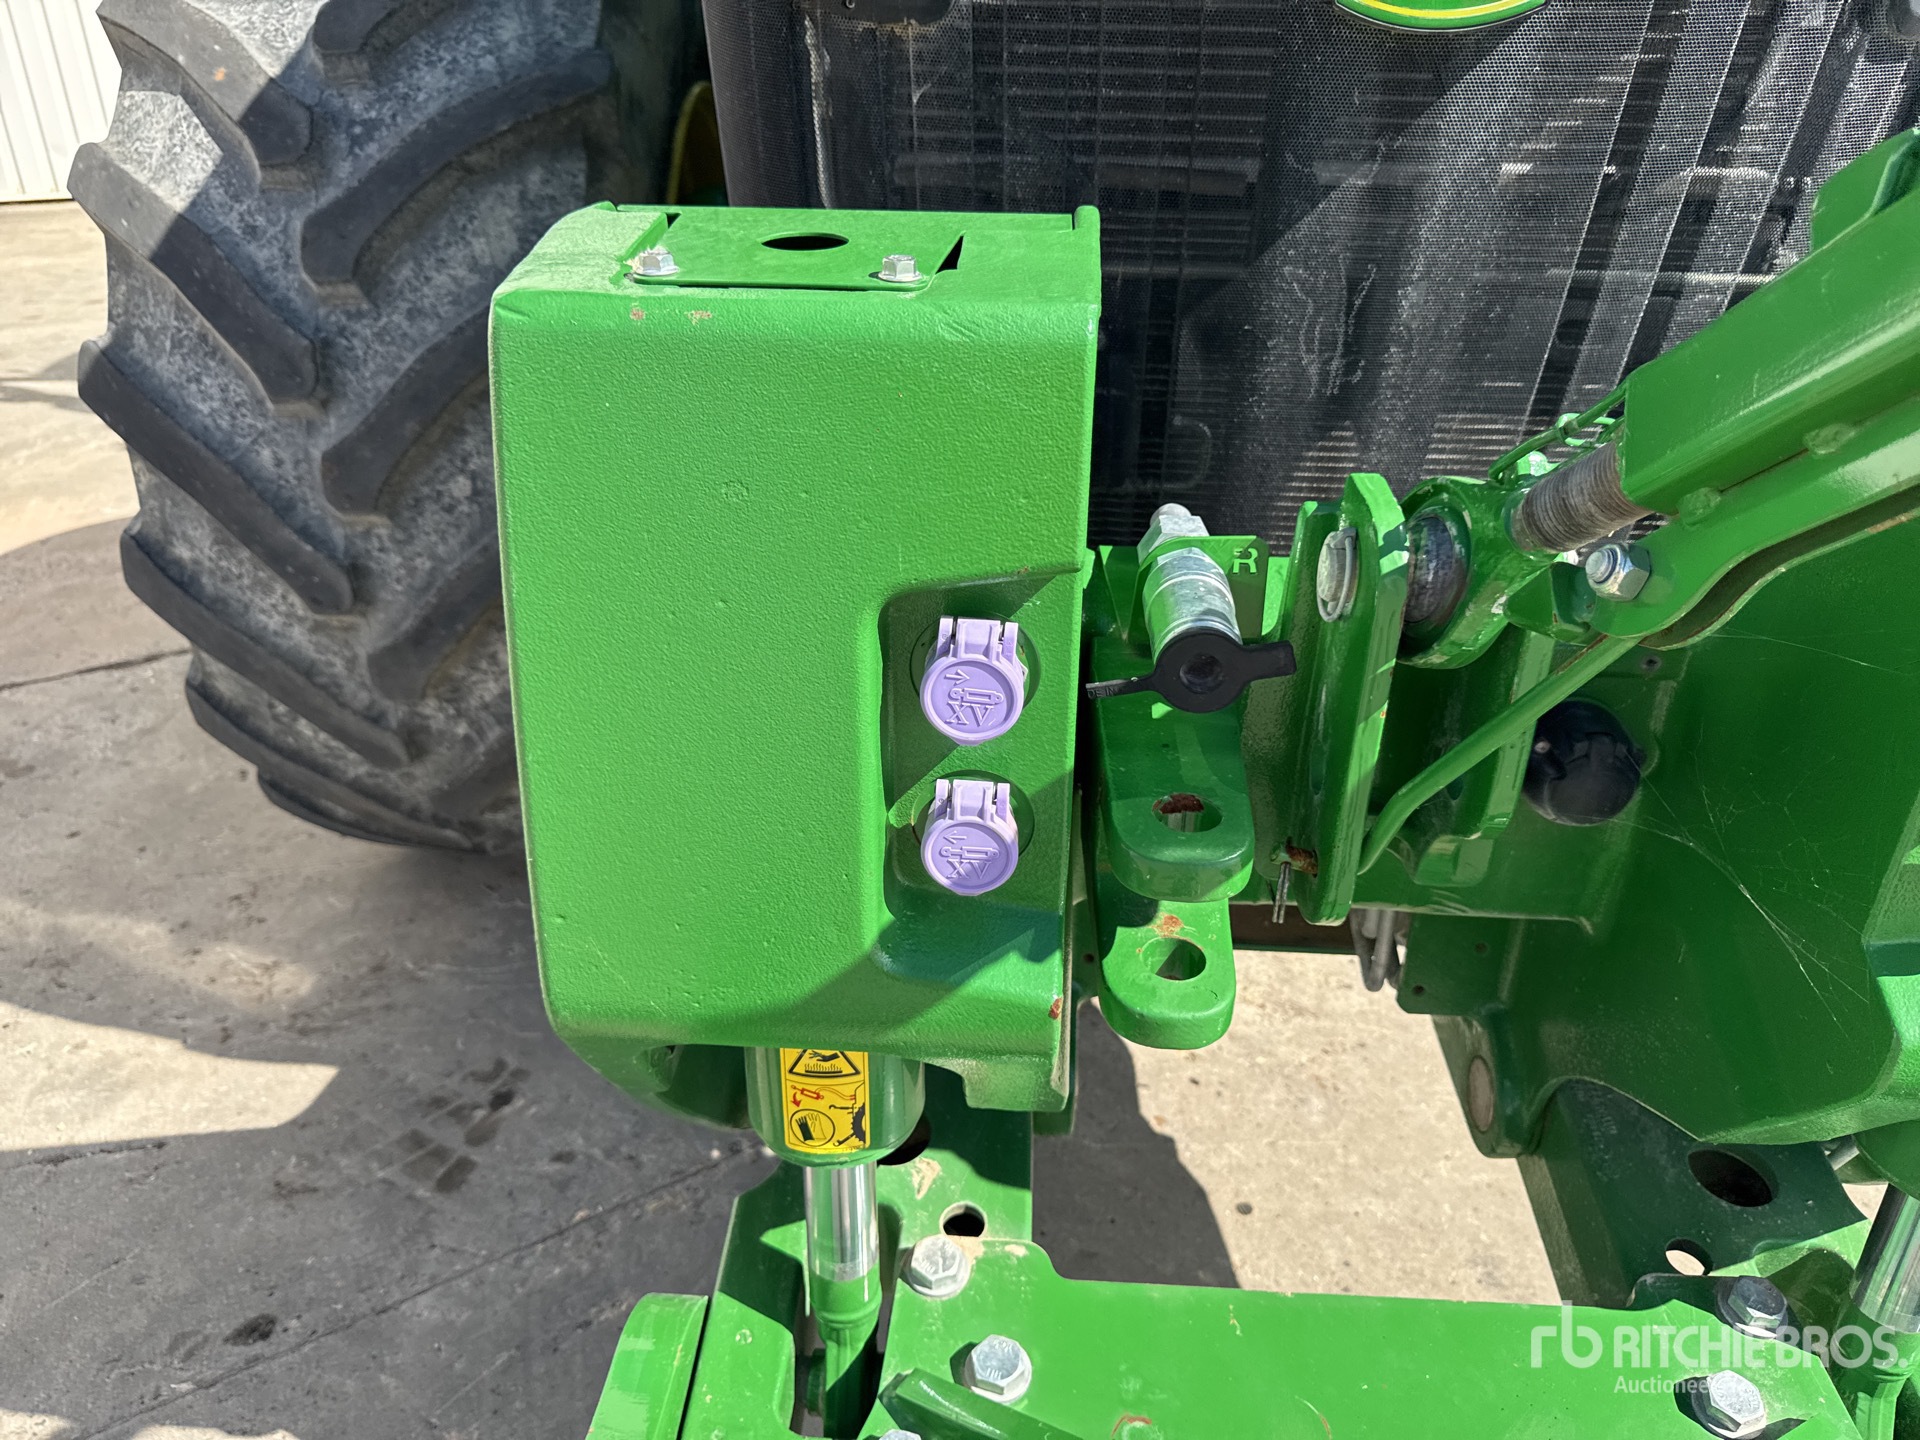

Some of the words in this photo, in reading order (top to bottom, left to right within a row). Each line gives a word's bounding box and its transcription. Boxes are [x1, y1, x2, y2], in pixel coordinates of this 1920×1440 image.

[1232, 547, 1258, 574] R
[945, 701, 994, 727] XV
[946, 857, 992, 880] XV
